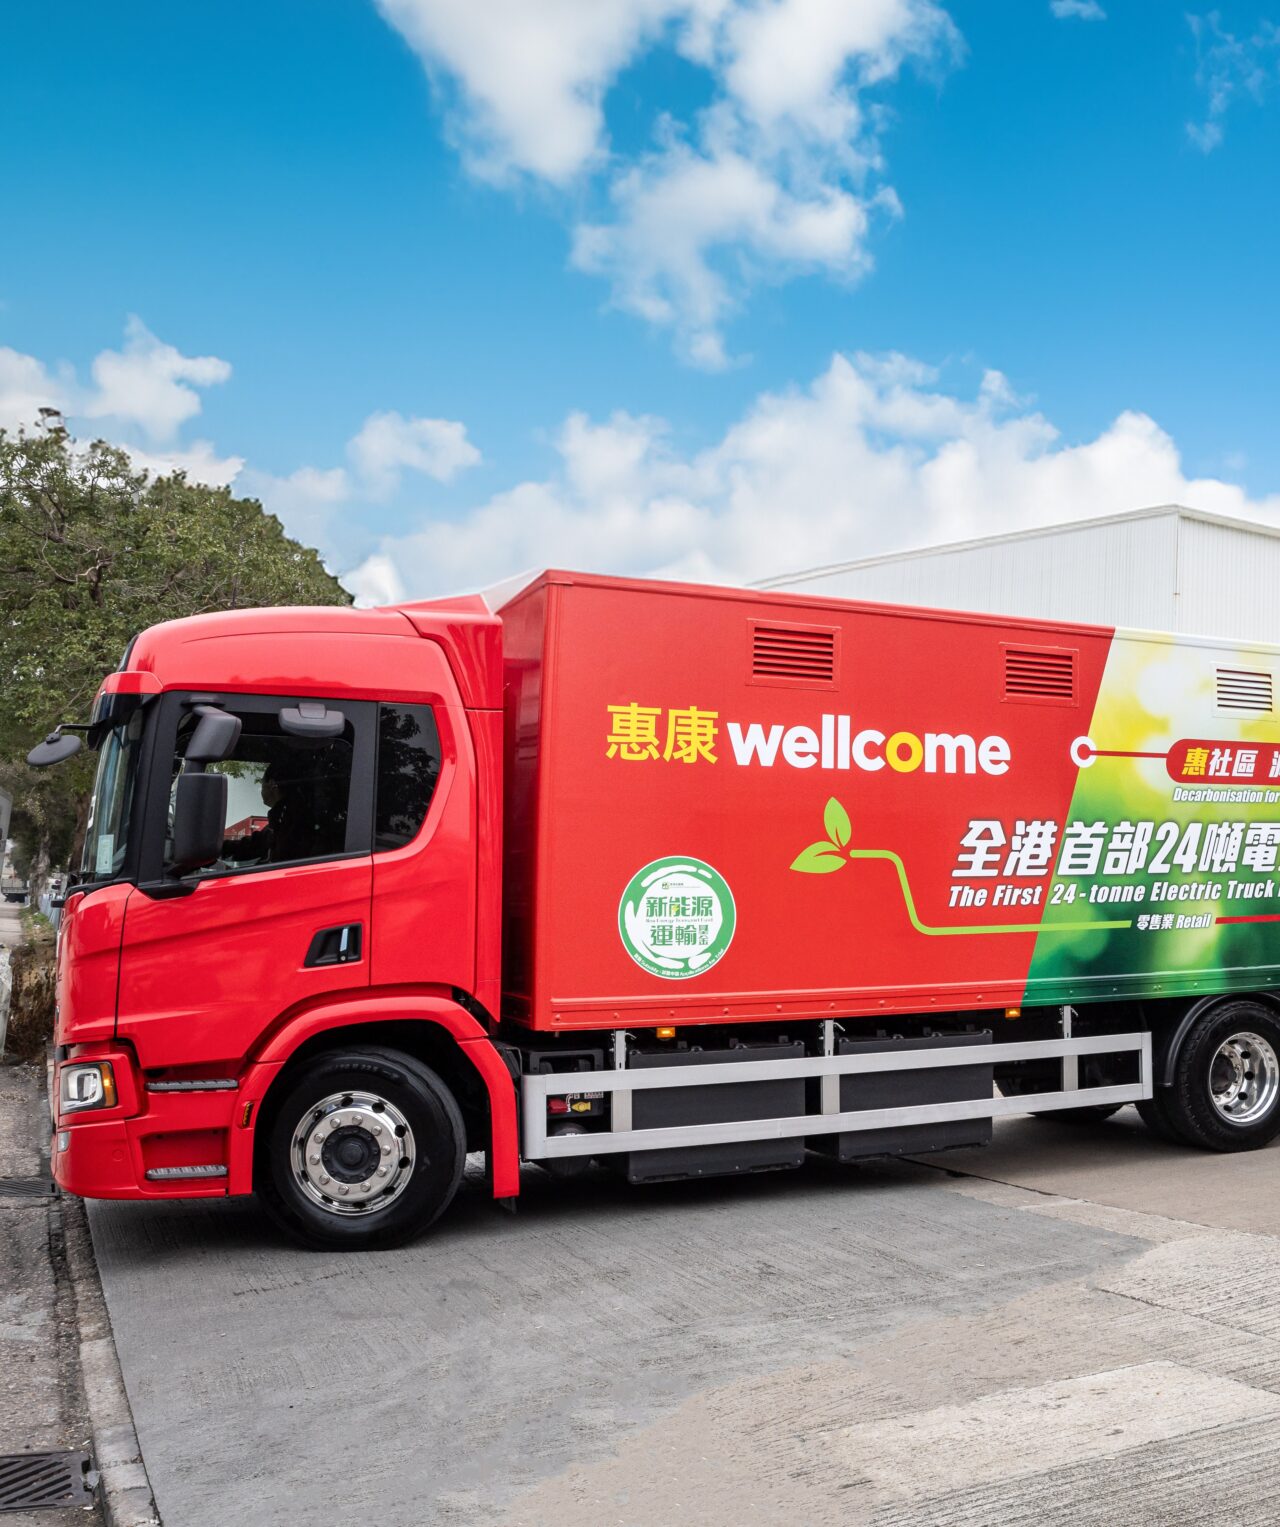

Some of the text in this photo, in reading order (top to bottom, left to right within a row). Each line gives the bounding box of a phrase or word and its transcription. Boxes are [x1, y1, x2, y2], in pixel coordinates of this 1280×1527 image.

[605, 702, 1011, 775] 惠康 wellcome
[1181, 748, 1258, 777] 惠社區
[1173, 787, 1263, 803] Decarbonisation
[1264, 791, 1280, 803] for
[949, 886, 987, 908] The
[992, 885, 1042, 906] First
[1150, 881, 1222, 902] Electric
[1227, 880, 1274, 900] Truck
[646, 896, 713, 917] 新能源
[1137, 914, 1212, 931] 零售業 Retail
